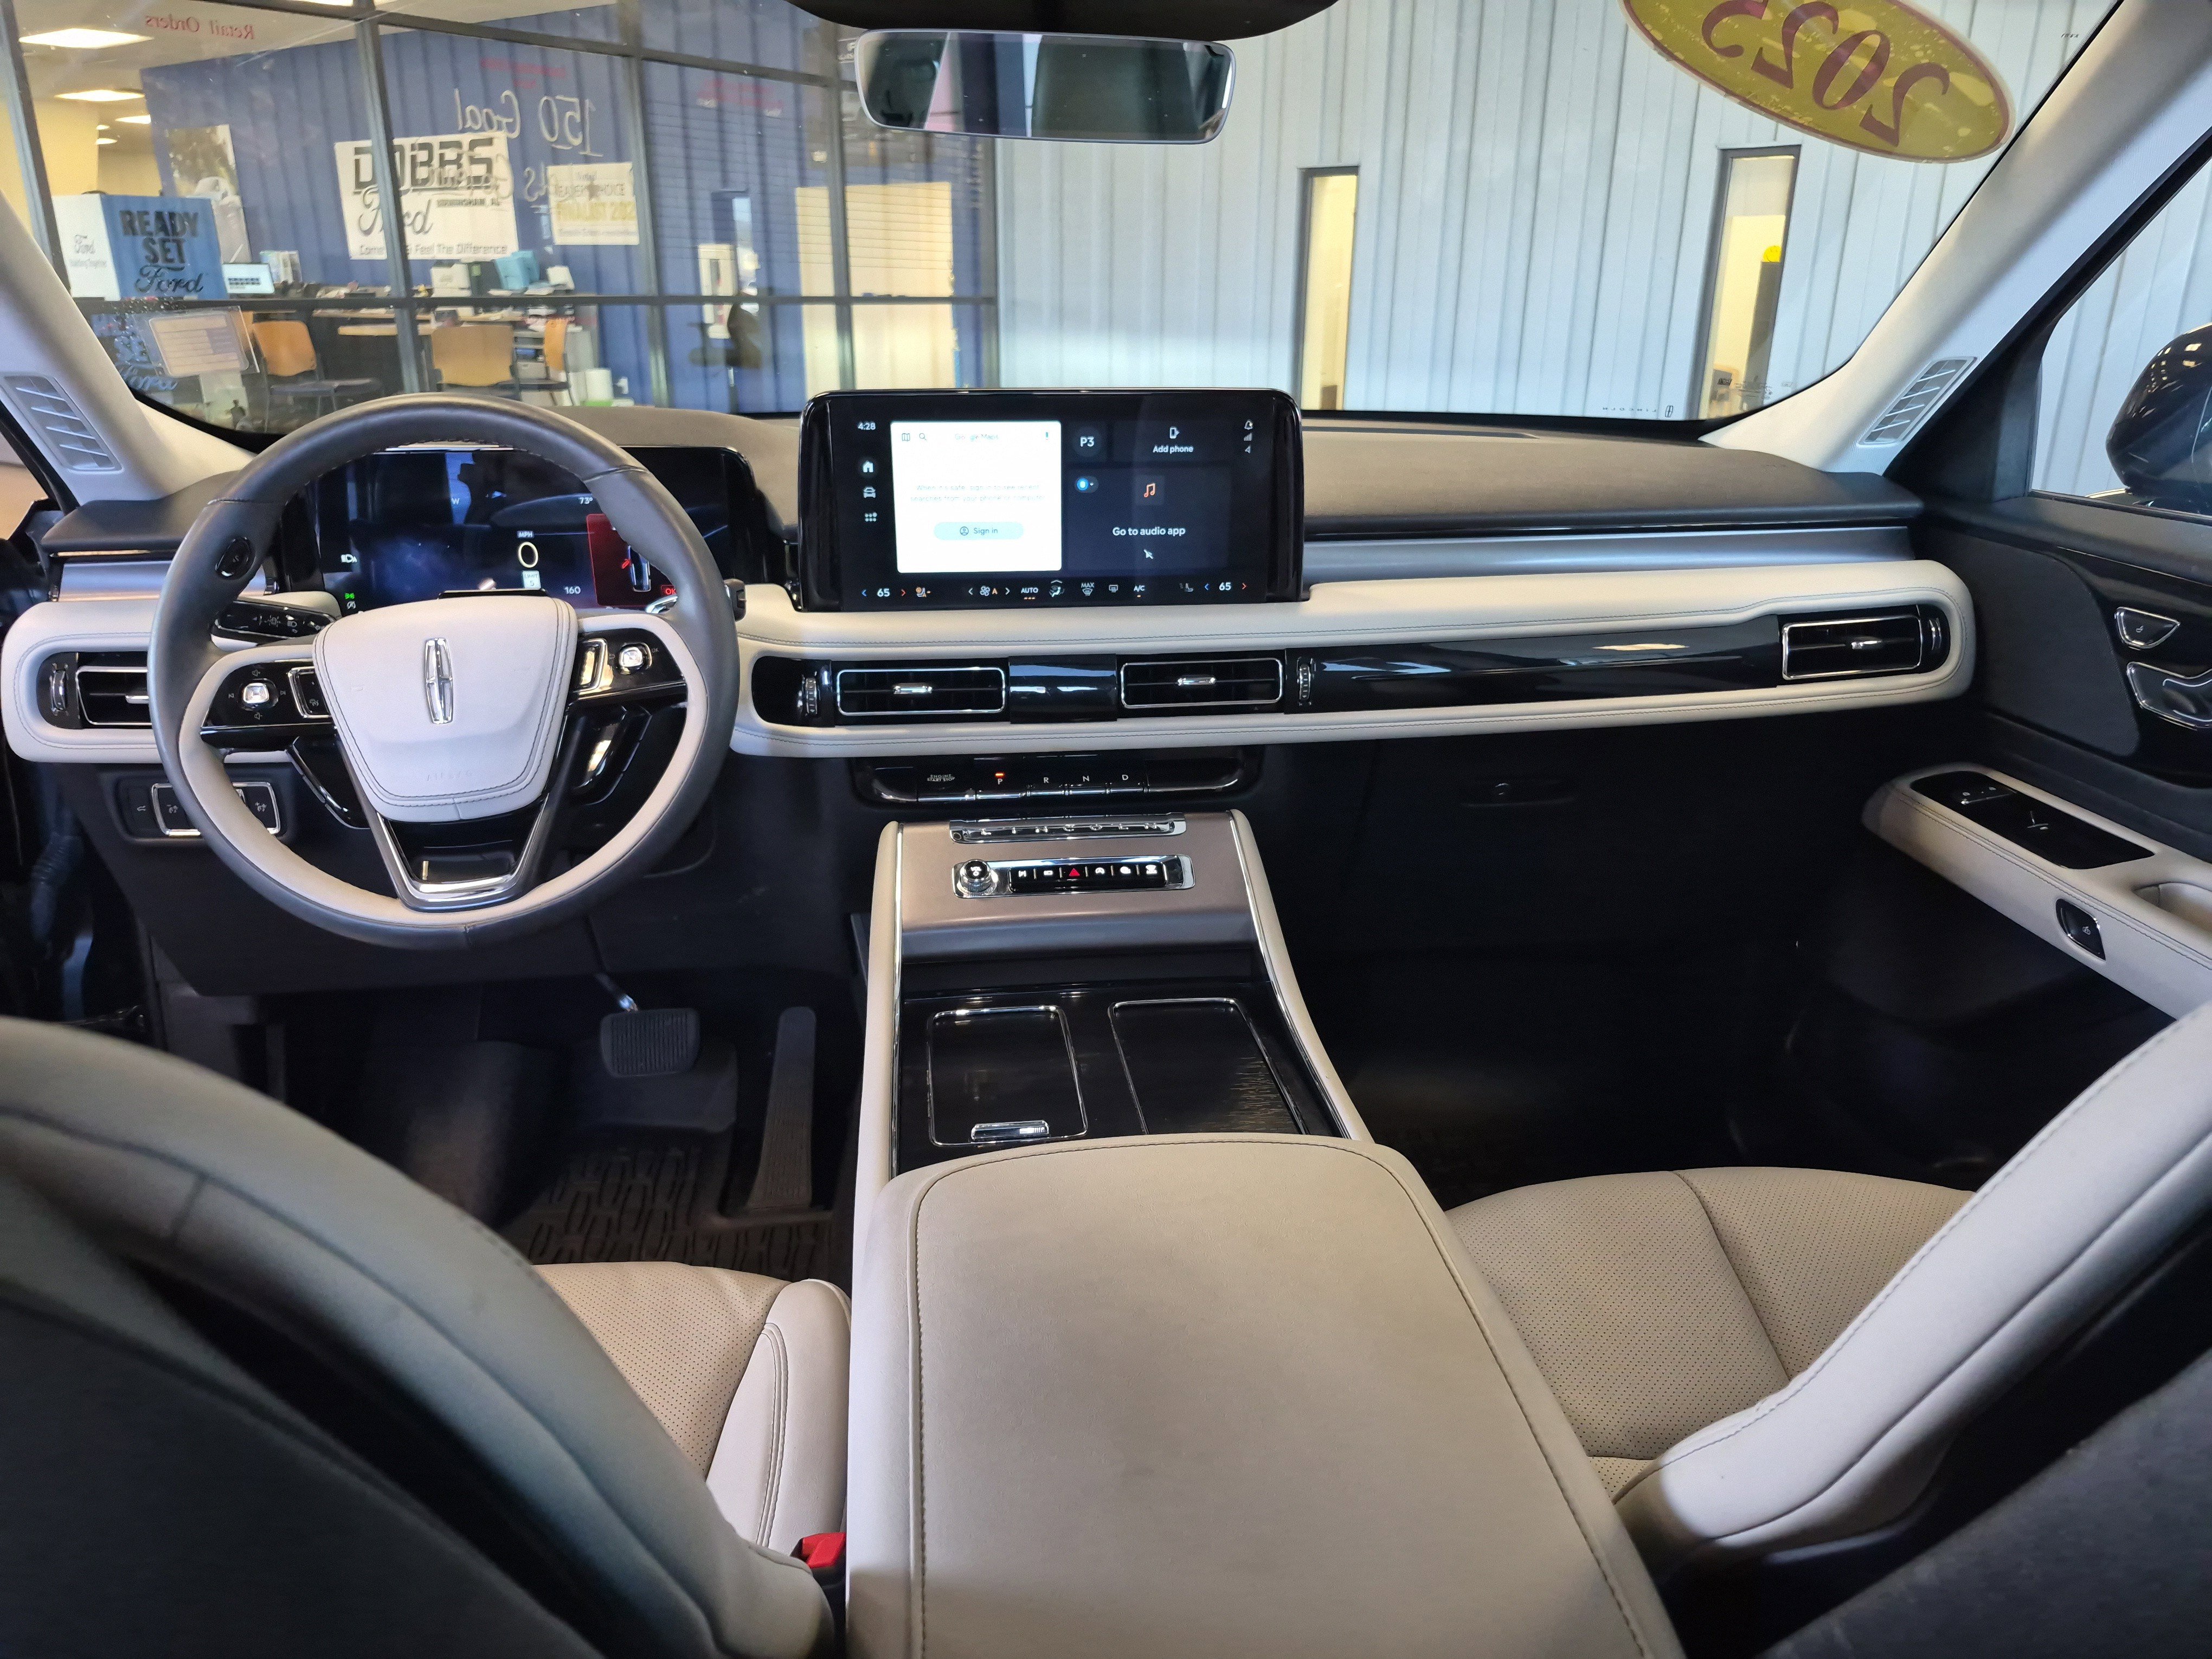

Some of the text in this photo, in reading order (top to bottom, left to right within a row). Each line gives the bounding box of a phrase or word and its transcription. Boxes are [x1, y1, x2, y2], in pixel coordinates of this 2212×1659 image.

[359, 185, 433, 236] Frd
[119, 210, 199, 237] READY
[142, 237, 186, 264] SET
[134, 265, 204, 293] Ford
[857, 422, 876, 431] 4:28
[1080, 436, 1095, 447] P3
[1153, 445, 1194, 454] Add phone
[973, 527, 989, 536] Sign
[1113, 528, 1126, 536] Go
[1140, 526, 1166, 536] audio
[1167, 528, 1186, 537] app
[518, 542, 539, 568] 0
[563, 586, 581, 594] 160
[1133, 584, 1146, 593] A/C
[1219, 582, 1232, 591] 65
[877, 589, 890, 597] 65
[980, 822, 1158, 835] LINCOLN
